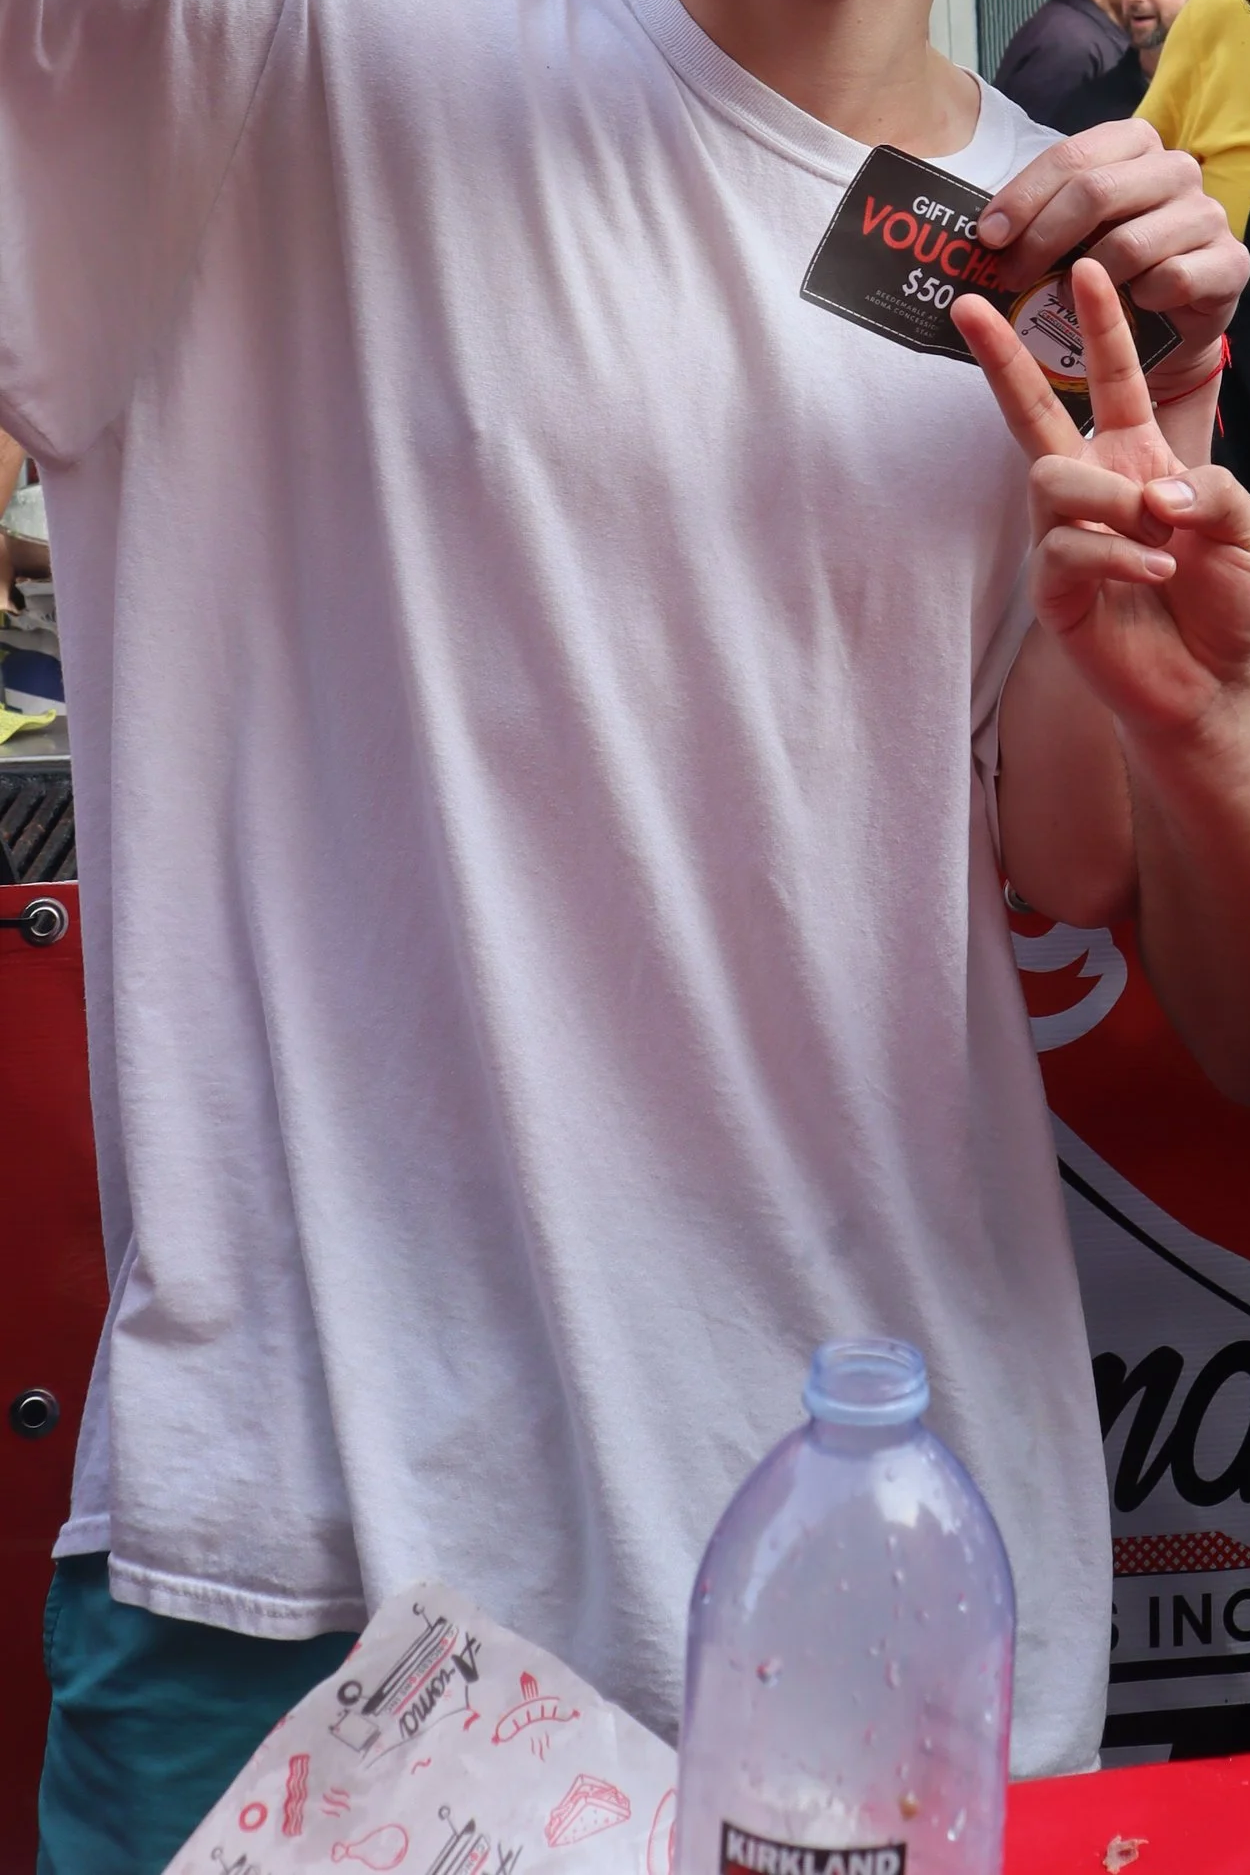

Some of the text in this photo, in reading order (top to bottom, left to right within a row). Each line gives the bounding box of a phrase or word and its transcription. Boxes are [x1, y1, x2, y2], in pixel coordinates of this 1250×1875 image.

[912, 195, 979, 240] GIFT FO
[865, 294, 892, 311] AROMA
[901, 267, 955, 310] $50
[726, 1829, 901, 1875] KIRKLAND
